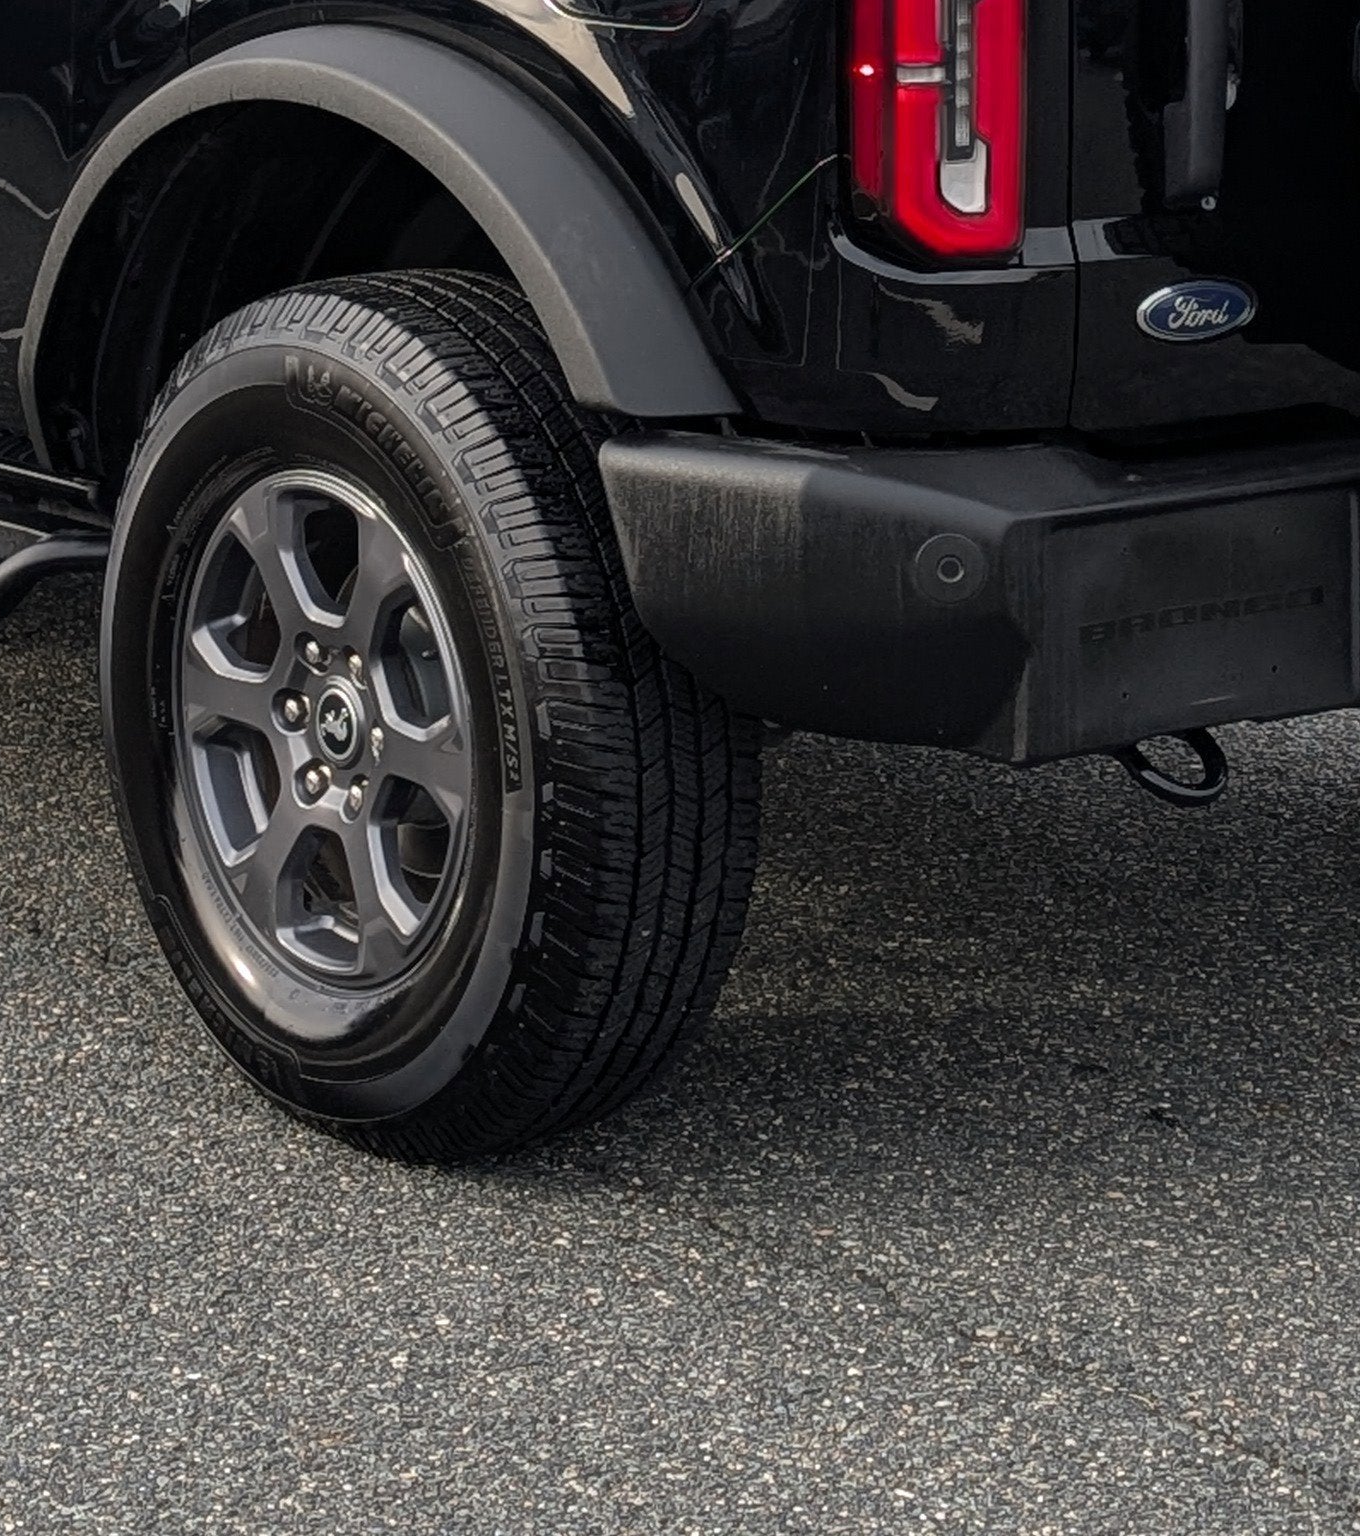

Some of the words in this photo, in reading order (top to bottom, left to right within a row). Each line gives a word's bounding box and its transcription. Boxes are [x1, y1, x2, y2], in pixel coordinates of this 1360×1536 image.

[1167, 295, 1230, 329] Ford
[334, 382, 460, 530] MICHELIN
[1078, 585, 1325, 644] BRONCO
[493, 672, 516, 719] LTX
